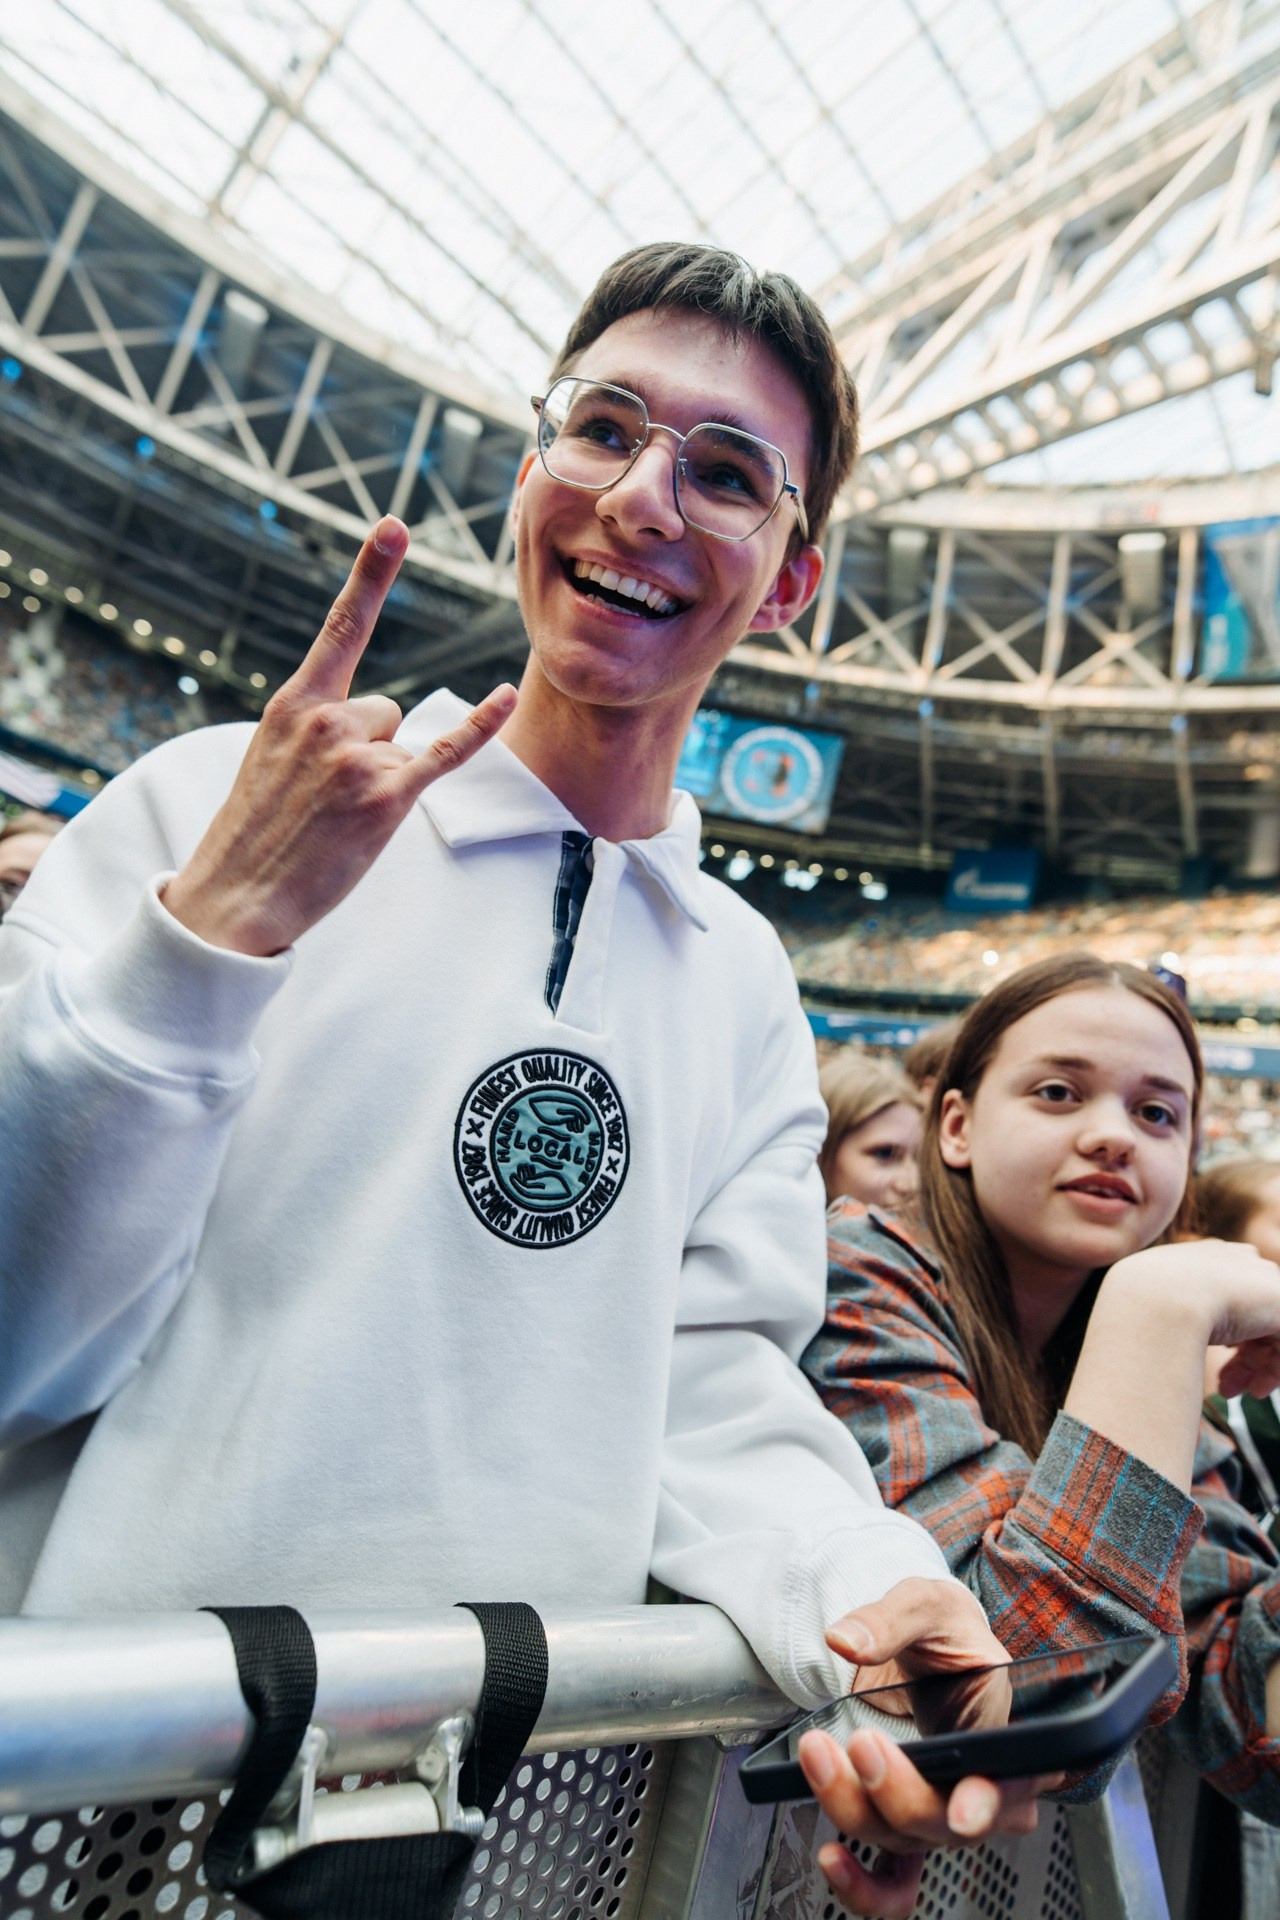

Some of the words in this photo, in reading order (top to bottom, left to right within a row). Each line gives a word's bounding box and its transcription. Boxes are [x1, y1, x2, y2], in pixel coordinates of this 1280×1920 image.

[470, 1065, 521, 1120] FINEST
[521, 1056, 587, 1087] QUALITY
[584, 1072, 617, 1119] SINCE
[606, 1114, 624, 1153] 1987
[497, 1109, 520, 1163] HAND
[514, 1130, 584, 1164] LOCAL
[578, 1131, 601, 1185] MADE
[462, 1141, 490, 1186] 1987
[474, 1180, 518, 1230] SINCE
[513, 1212, 575, 1241] QUALITY
[575, 1173, 616, 1228] FINEST
